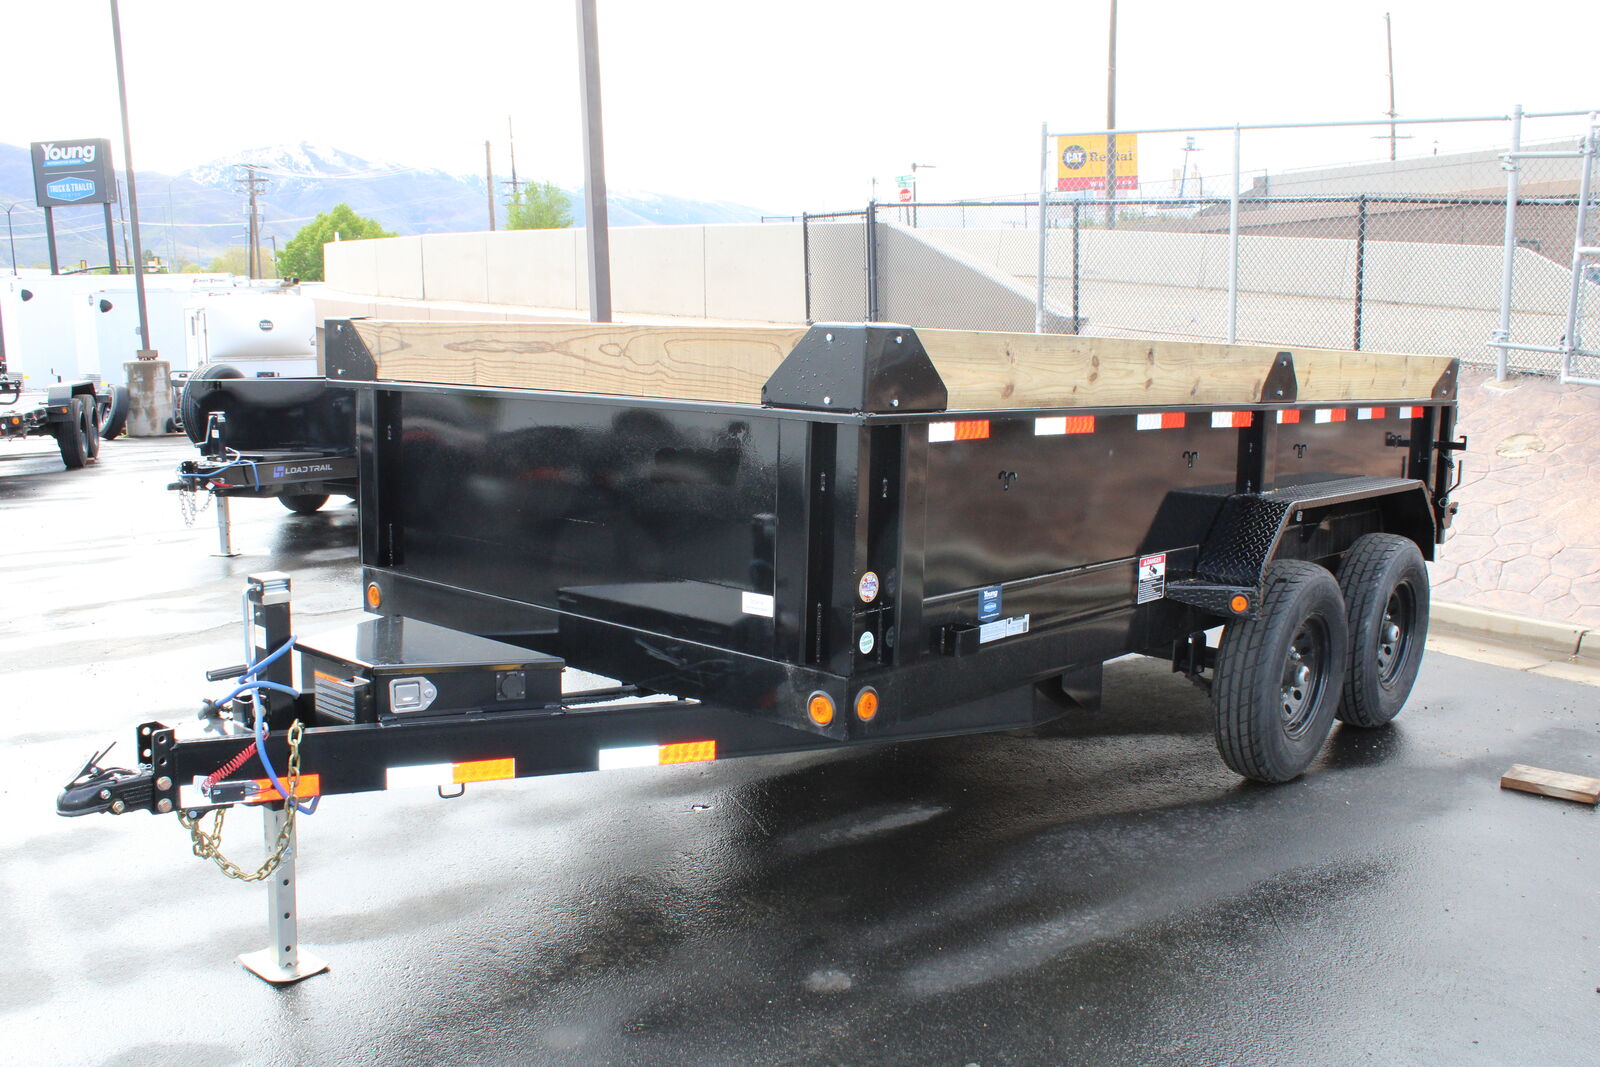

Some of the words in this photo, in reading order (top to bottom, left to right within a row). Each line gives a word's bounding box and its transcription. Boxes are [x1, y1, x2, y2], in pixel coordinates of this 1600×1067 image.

[41, 144, 95, 162] Young
[1066, 152, 1083, 162] CAT
[1089, 151, 1133, 162] Retal
[50, 185, 65, 193] TRUCK
[71, 182, 93, 192] TRAILER
[285, 466, 308, 474] LOAD
[309, 464, 332, 472] TRAIL
